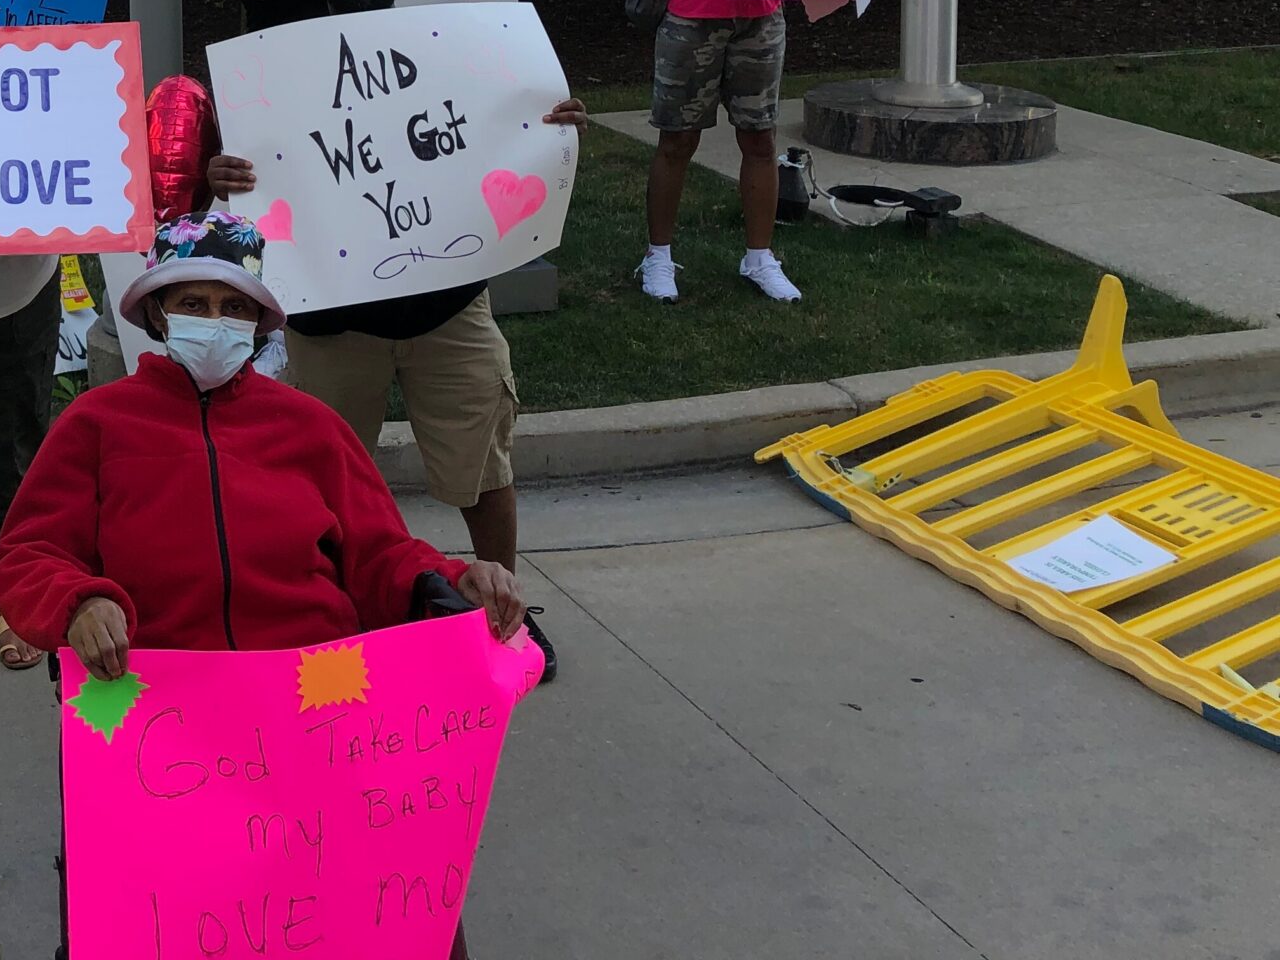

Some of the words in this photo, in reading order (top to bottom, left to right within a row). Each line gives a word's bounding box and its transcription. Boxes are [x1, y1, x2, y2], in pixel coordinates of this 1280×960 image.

[332, 32, 418, 109] AND
[137, 707, 271, 800] God
[305, 712, 405, 768] TAKE
[416, 704, 496, 754] CARE
[362, 766, 479, 840] BABY
